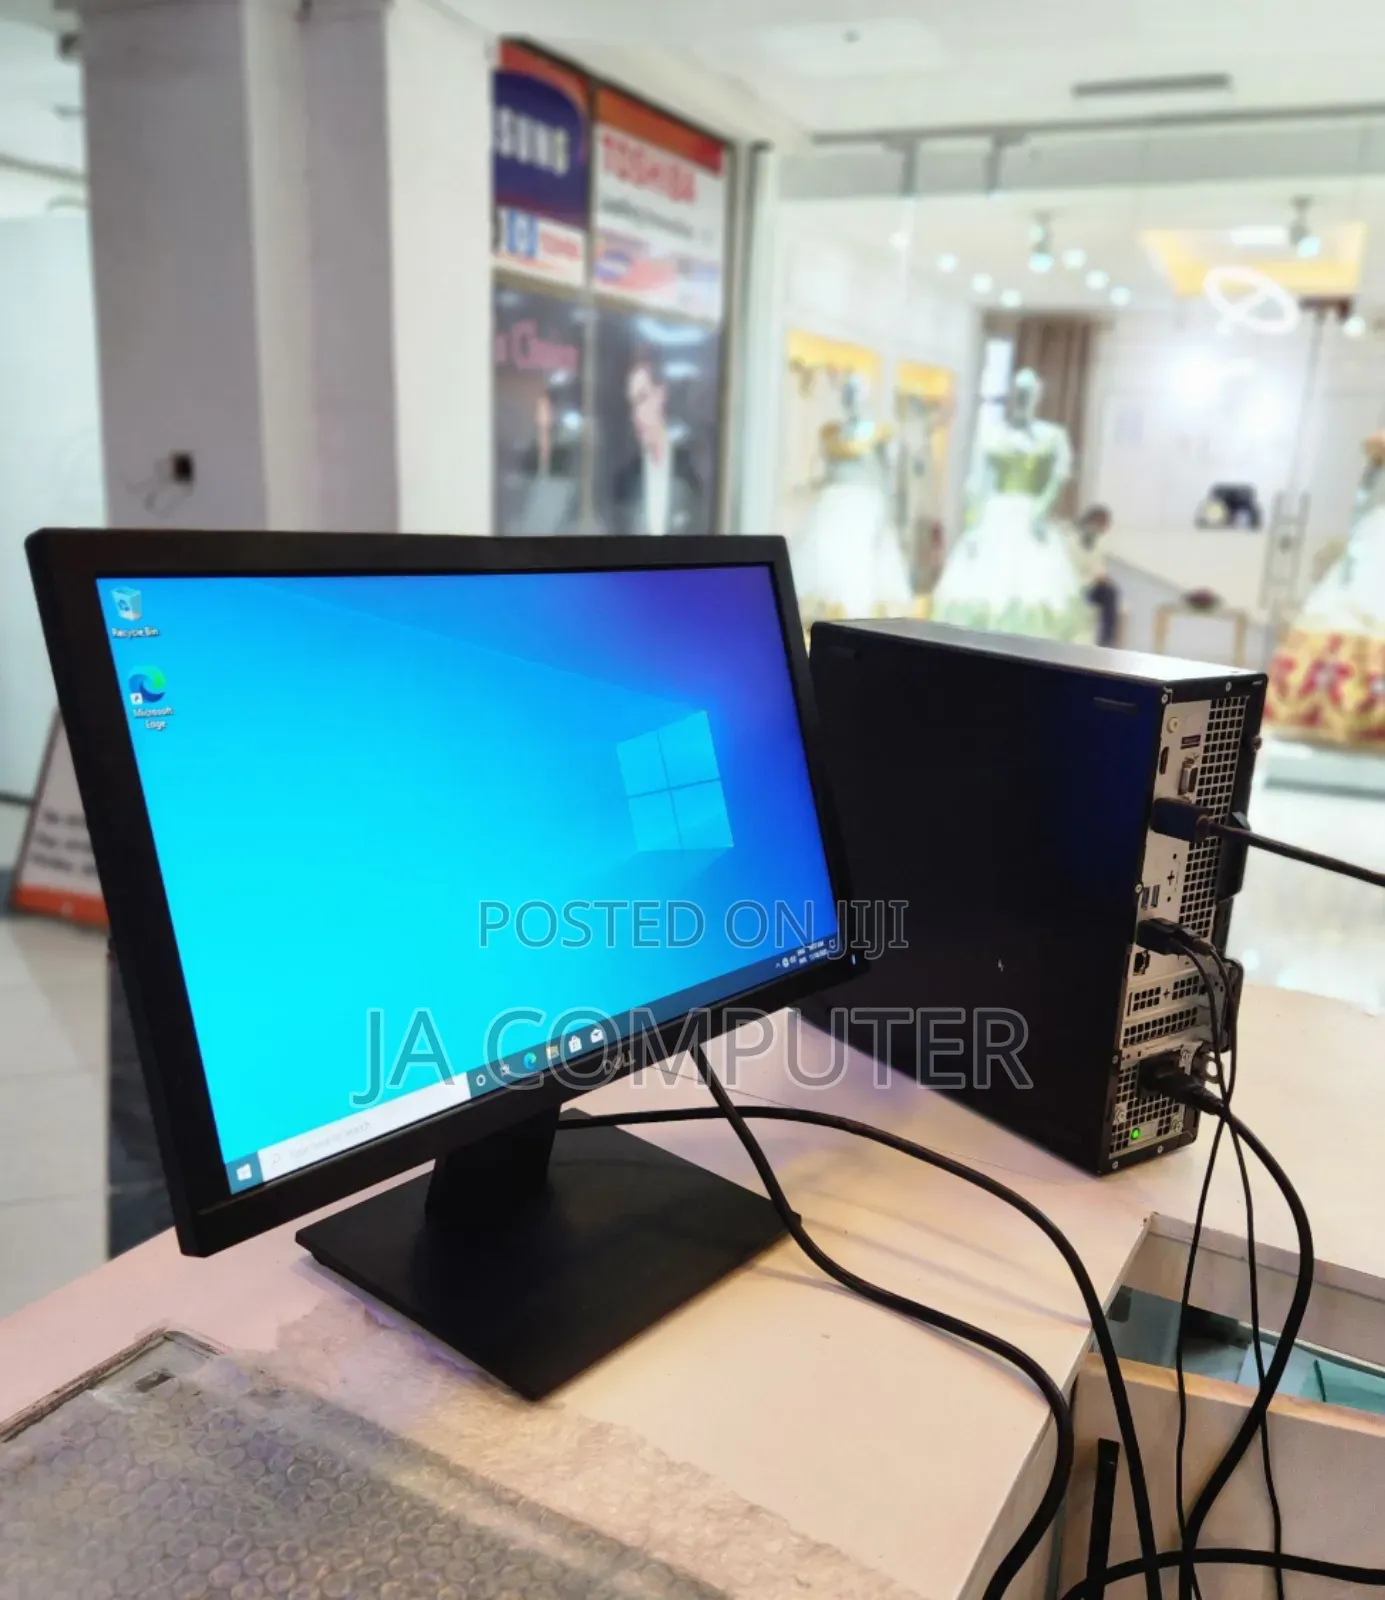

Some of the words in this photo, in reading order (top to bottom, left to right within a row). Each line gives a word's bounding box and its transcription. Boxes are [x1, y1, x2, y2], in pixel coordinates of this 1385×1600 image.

[112, 627, 143, 639] Recycle
[144, 626, 159, 637] Bin
[133, 706, 173, 718] Microsoft
